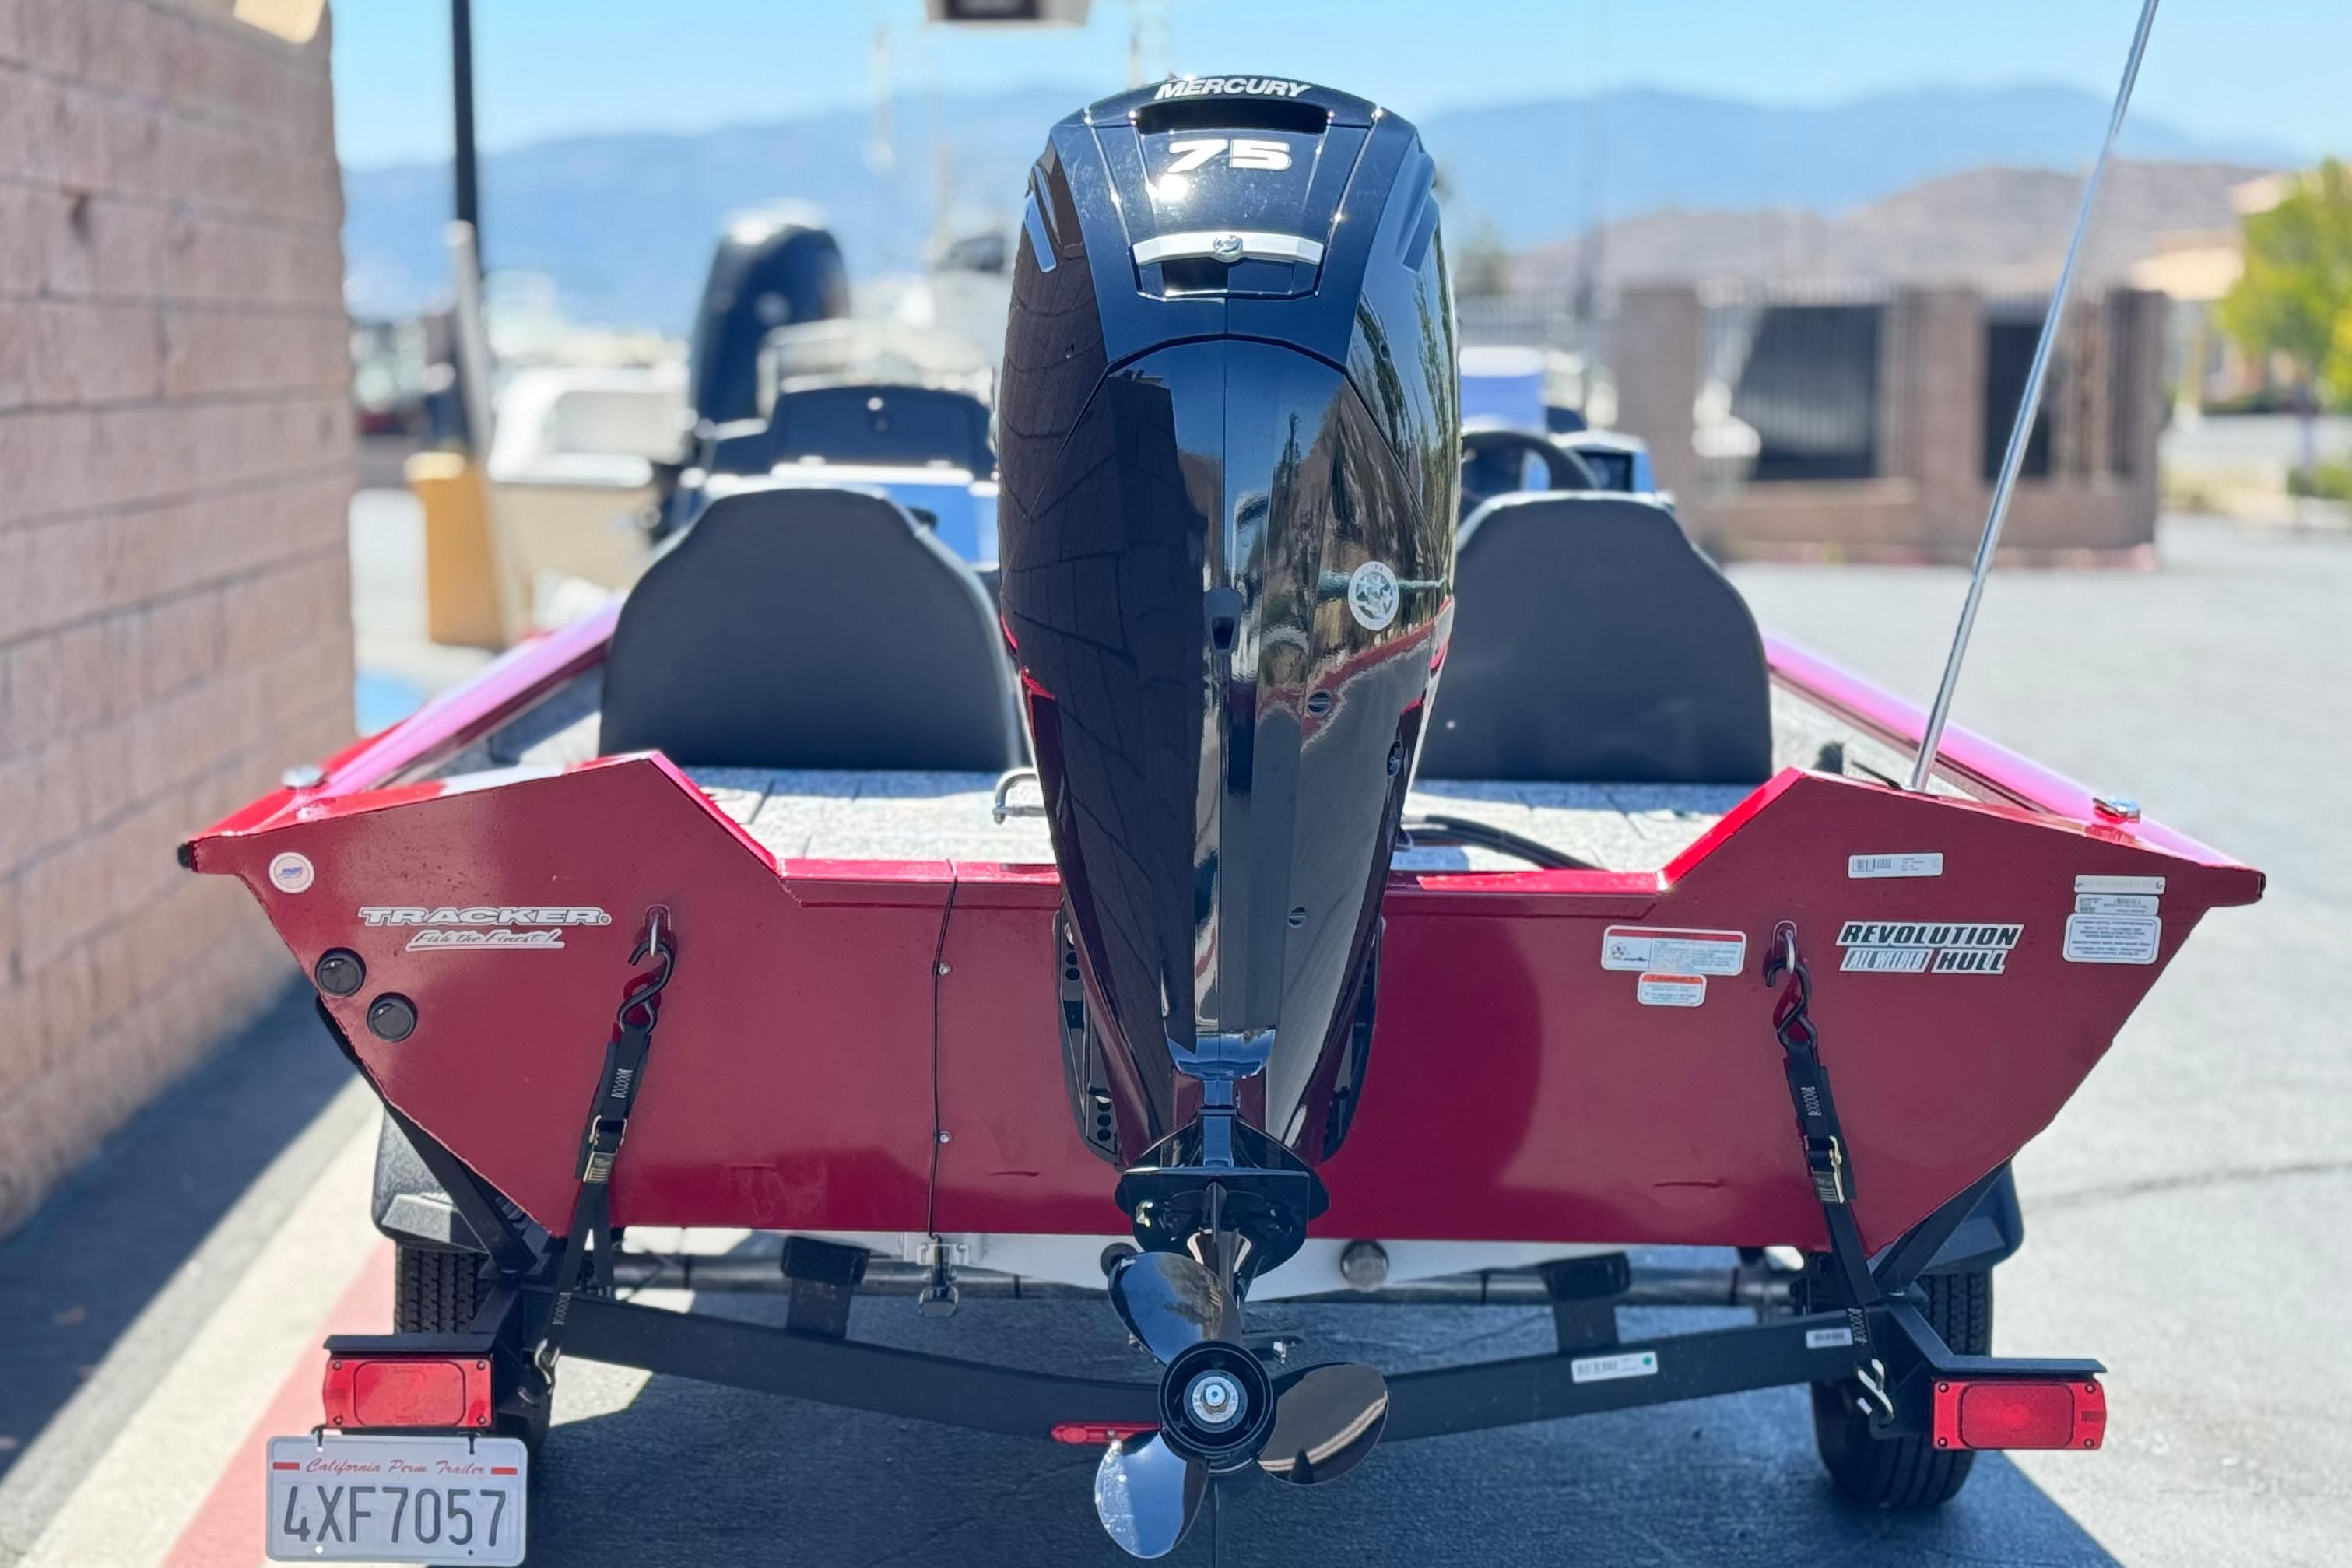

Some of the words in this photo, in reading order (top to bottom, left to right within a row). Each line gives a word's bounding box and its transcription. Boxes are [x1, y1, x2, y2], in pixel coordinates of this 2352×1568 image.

[1154, 77, 1311, 100] MERCURY
[1168, 139, 1292, 174] 75
[361, 909, 600, 924] TRACKER
[414, 932, 452, 943] Fish
[456, 931, 482, 943] the
[1841, 924, 2019, 945] REVOLUTION
[1936, 952, 2003, 970] HULL
[306, 1458, 381, 1475] California
[388, 1459, 427, 1473] Perm
[436, 1460, 486, 1475] Trailer
[284, 1486, 506, 1547] 4XF7057
